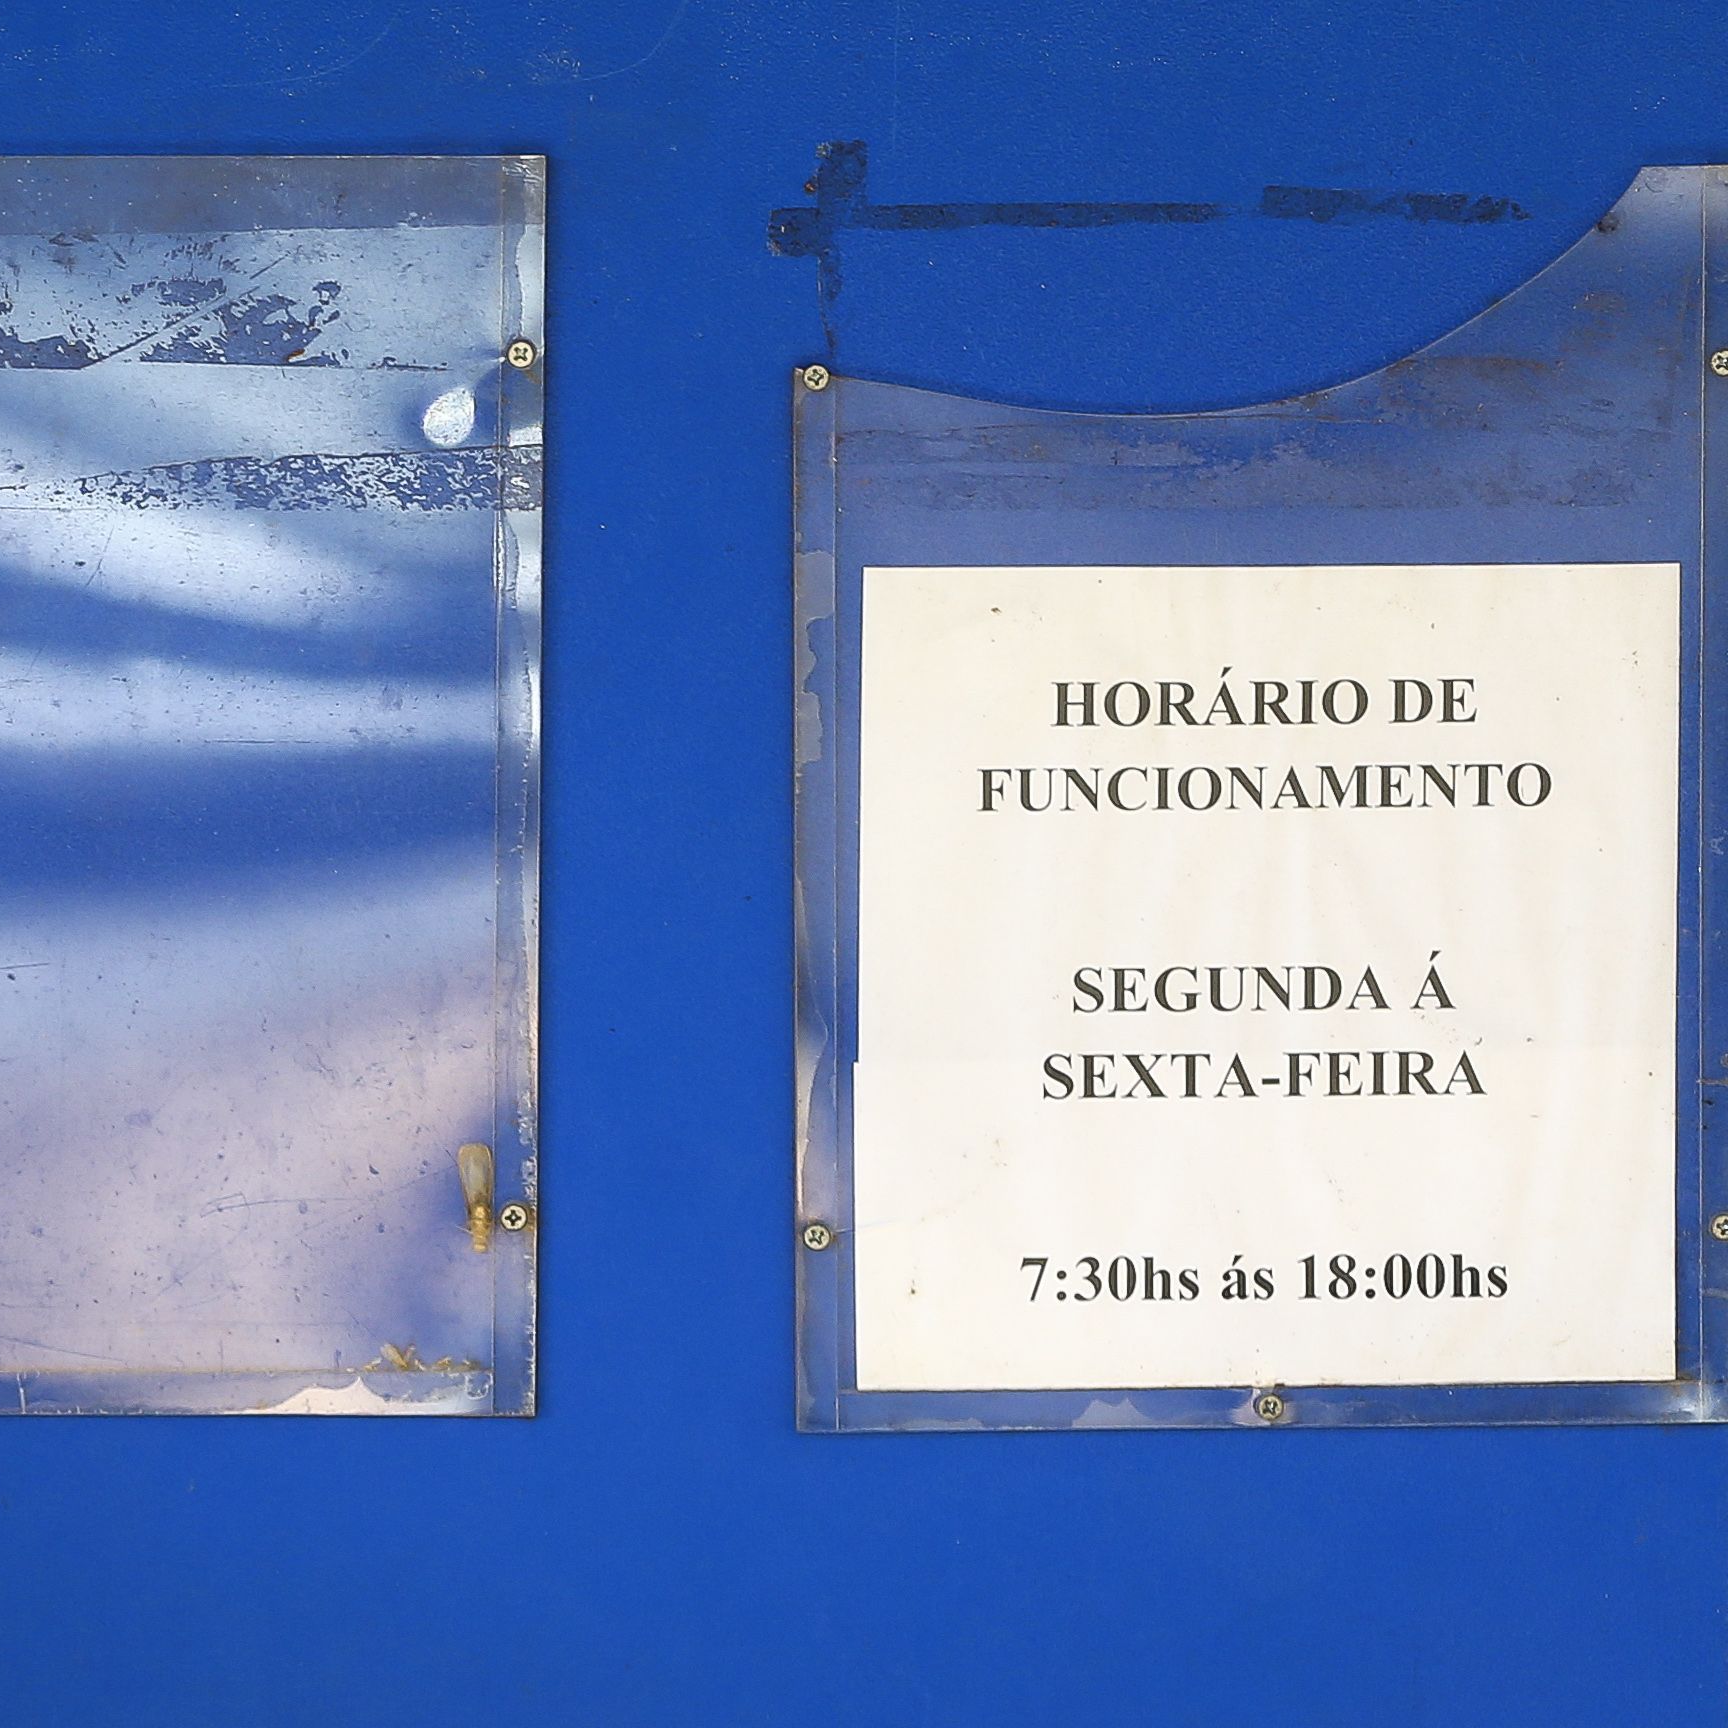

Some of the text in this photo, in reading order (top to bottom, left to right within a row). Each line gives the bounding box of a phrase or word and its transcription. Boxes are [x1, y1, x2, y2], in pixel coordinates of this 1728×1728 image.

[1052, 667, 1477, 727] HORÁRIO DE
[978, 763, 1551, 811] FUNCIONAMENTO
[1073, 951, 1456, 1013] SEGUNDA Á
[1043, 1050, 1487, 1099] SEXTA-FEIRA
[1021, 1253, 1507, 1301] 7:30hs ás 18:00hs
